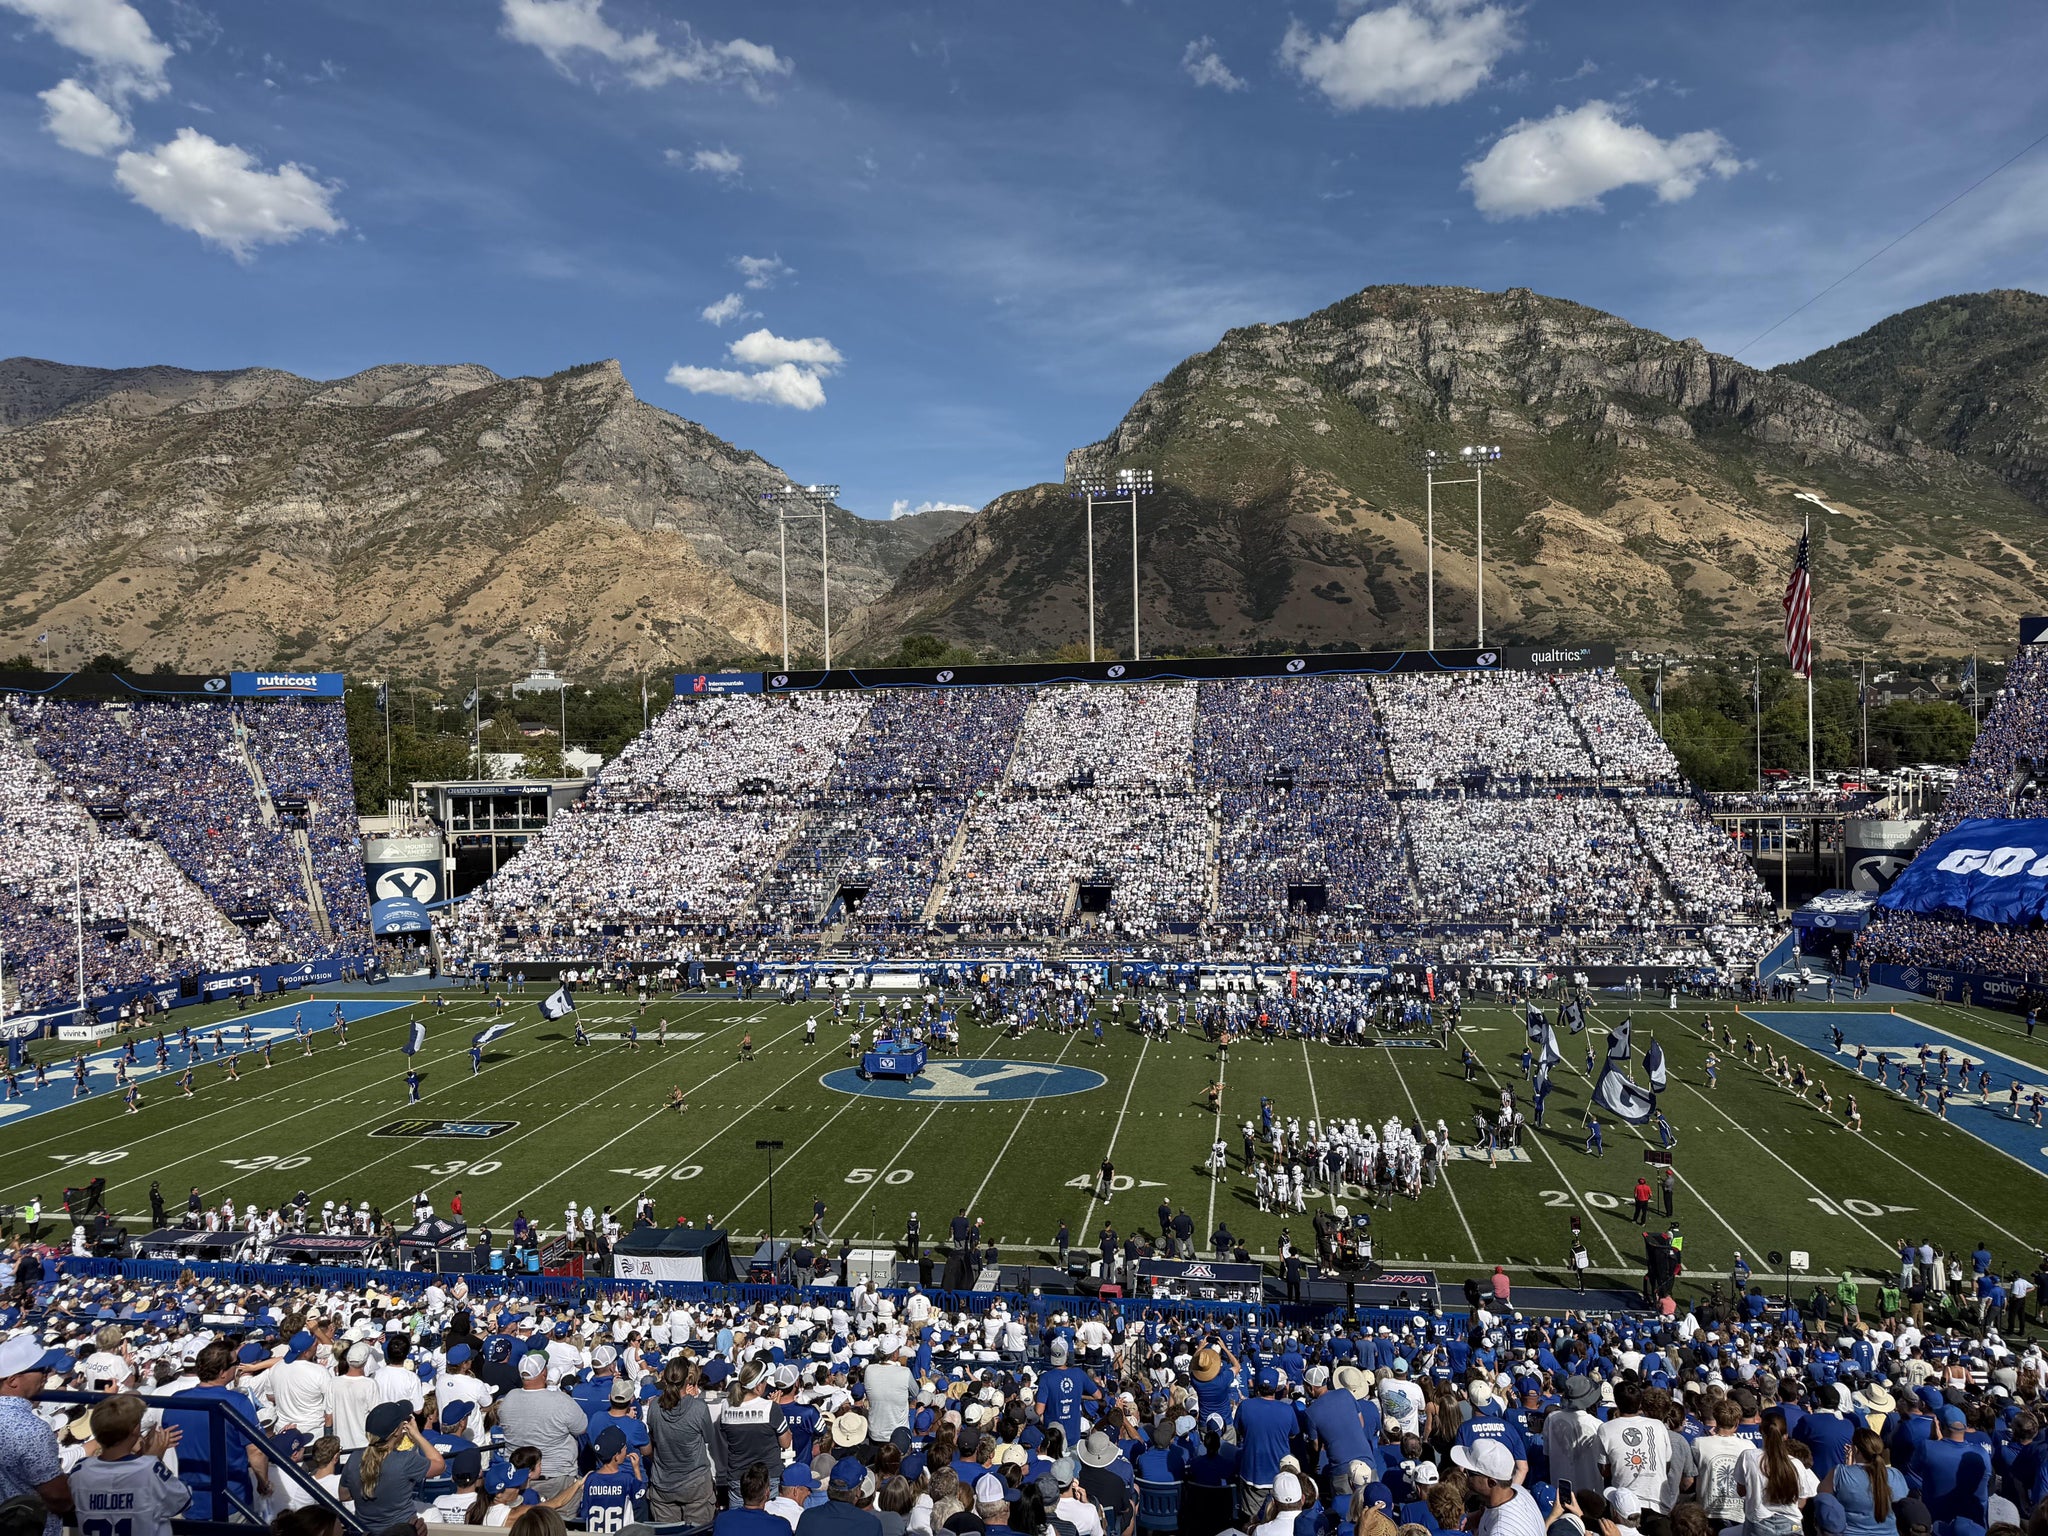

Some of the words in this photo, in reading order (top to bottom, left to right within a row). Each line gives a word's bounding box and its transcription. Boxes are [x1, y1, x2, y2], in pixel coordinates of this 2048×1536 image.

[257, 675, 317, 686] nutricost
[1936, 847, 2038, 877] GO
[310, 972, 332, 981] VISION
[65, 1151, 130, 1165] 10
[232, 1155, 312, 1170] 20
[430, 1160, 502, 1176] 30
[632, 1164, 704, 1180] 40
[844, 1168, 915, 1185] 50
[1064, 1174, 1136, 1191] 40
[1538, 1190, 1619, 1209] 20
[1808, 1197, 1884, 1217] 10
[1181, 1263, 1217, 1279] A
[1434, 1324, 1447, 1336] 12
[724, 1410, 764, 1420] COUGARS
[1472, 1423, 1483, 1432] GO
[1482, 1422, 1506, 1432] COUGS
[589, 1484, 622, 1496] COUGARS
[89, 1493, 134, 1510] HOLDER
[588, 1505, 621, 1533] 26
